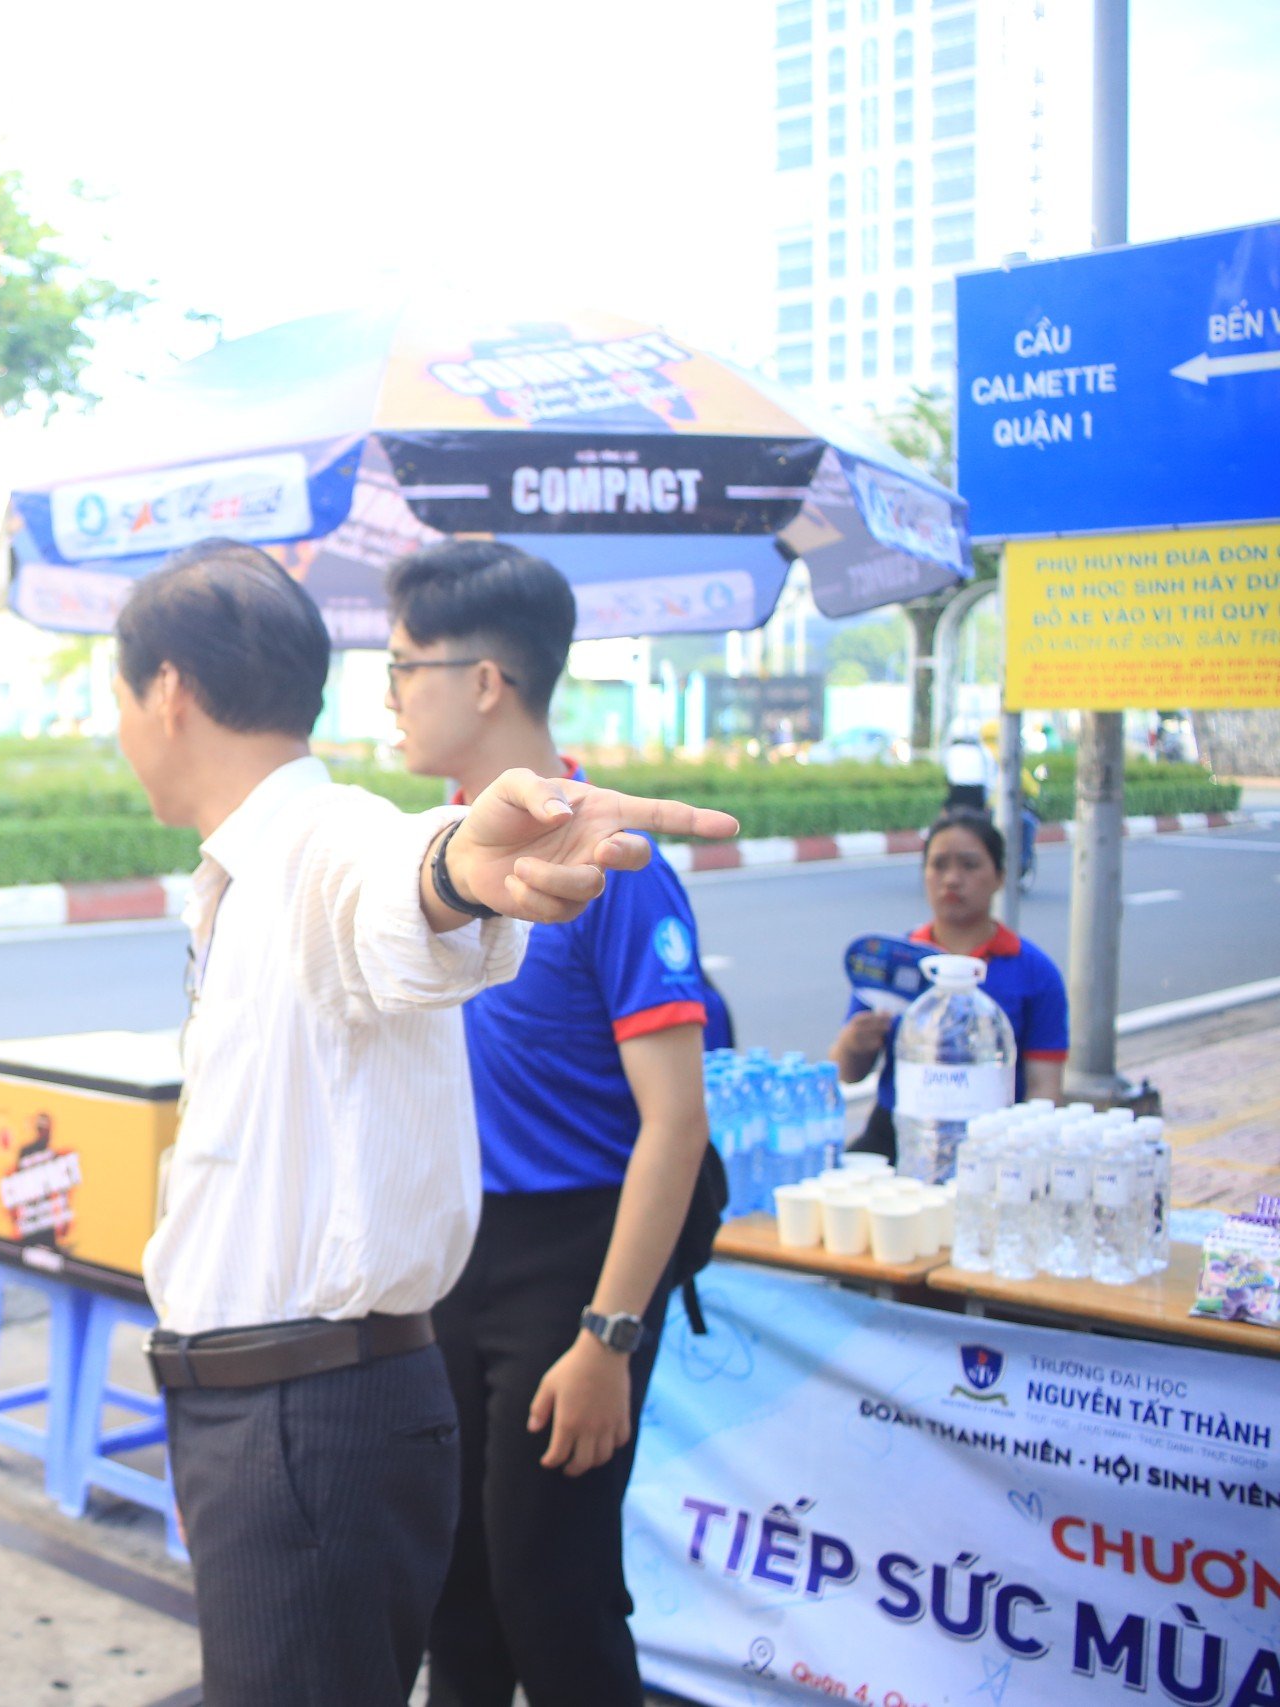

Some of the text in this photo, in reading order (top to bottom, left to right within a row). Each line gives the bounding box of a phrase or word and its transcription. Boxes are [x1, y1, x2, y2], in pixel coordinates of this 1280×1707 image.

[1014, 316, 1071, 358] CẦU
[1208, 298, 1264, 344] BẾN
[429, 331, 684, 397] COMPACT
[971, 363, 1117, 405] CALMETTE
[993, 408, 1093, 450] QUẬN 1
[511, 466, 703, 515] COMPACT
[1084, 551, 1158, 571] HUYNH
[1046, 582, 1076, 600] EM
[1135, 577, 1186, 597] SINH
[1222, 602, 1271, 622] QUY
[1030, 1353, 1189, 1400] TRƯỜNG ĐẠI HỌC
[1026, 1381, 1272, 1449] NGUYỄN TẤT THÀNH
[859, 1398, 923, 1428] ĐOÀN
[926, 1417, 1006, 1455] THANH
[1013, 1437, 1072, 1467] NIÊN
[1093, 1454, 1140, 1486] HỘI
[1147, 1466, 1210, 1497] SINH
[1218, 1480, 1280, 1509] VIÊN
[681, 1496, 858, 1601] TIẾP
[874, 1551, 1052, 1661] SỨC
